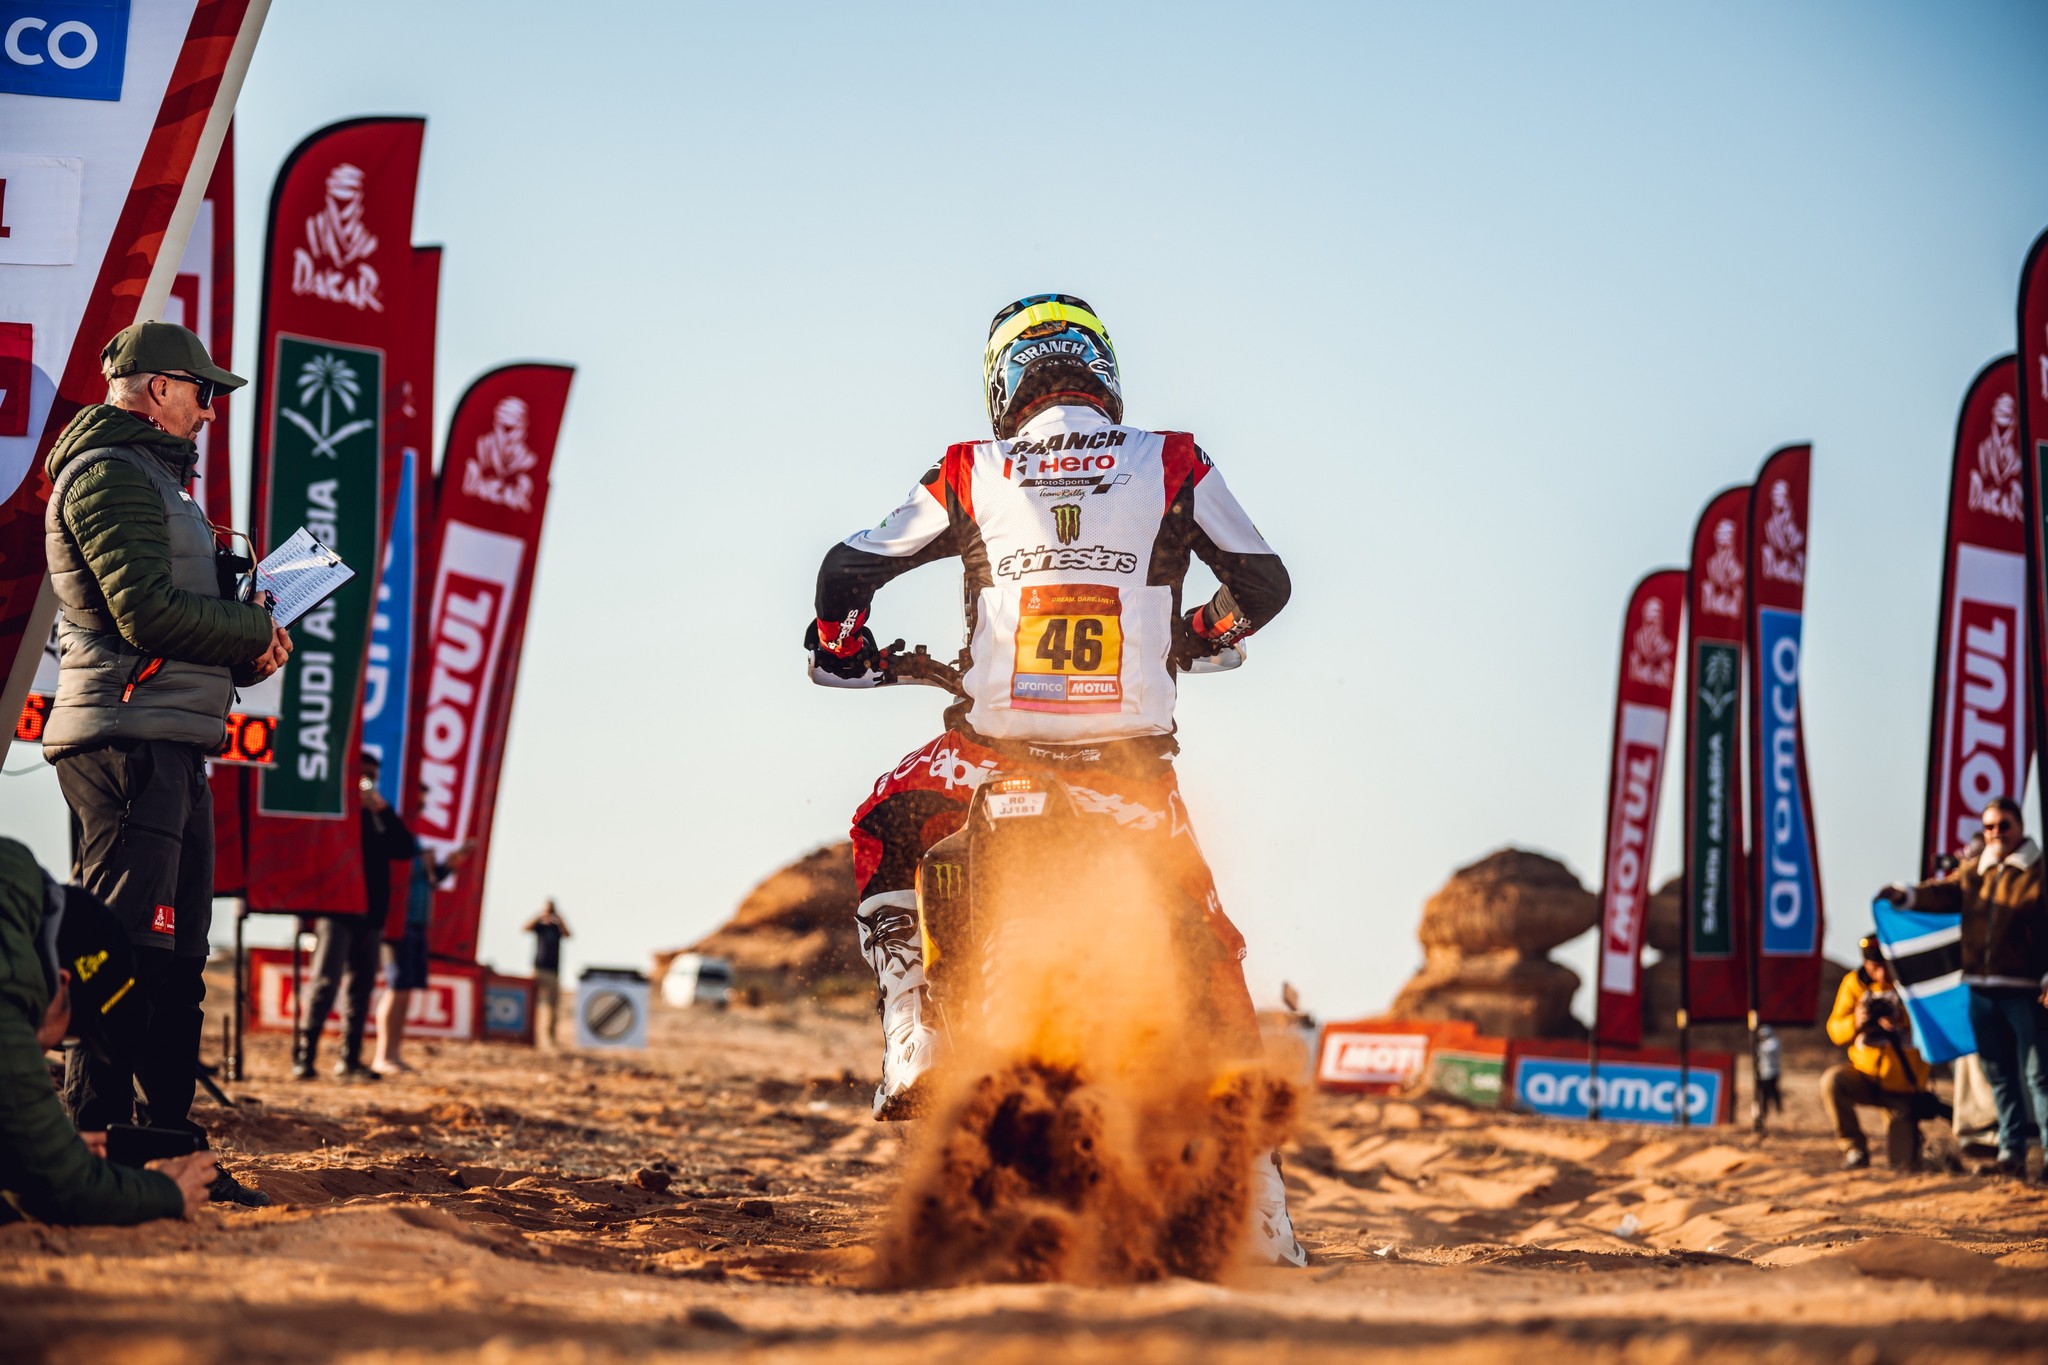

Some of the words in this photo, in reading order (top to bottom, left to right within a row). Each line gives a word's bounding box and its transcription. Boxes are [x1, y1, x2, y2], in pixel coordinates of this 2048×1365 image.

[1012, 340, 1086, 366] BRANCH
[1039, 454, 1116, 473] Hero
[1034, 478, 1090, 487] MotoSports
[998, 545, 1138, 580] alpinestars
[1036, 618, 1103, 671] 46
[1017, 681, 1063, 692] aramco
[1071, 682, 1116, 693] MOTUL
[298, 650, 336, 782] SAUDI
[419, 588, 494, 832] MOTUL
[1612, 755, 1654, 945] MOTUL
[1526, 1073, 1708, 1117] aramco
